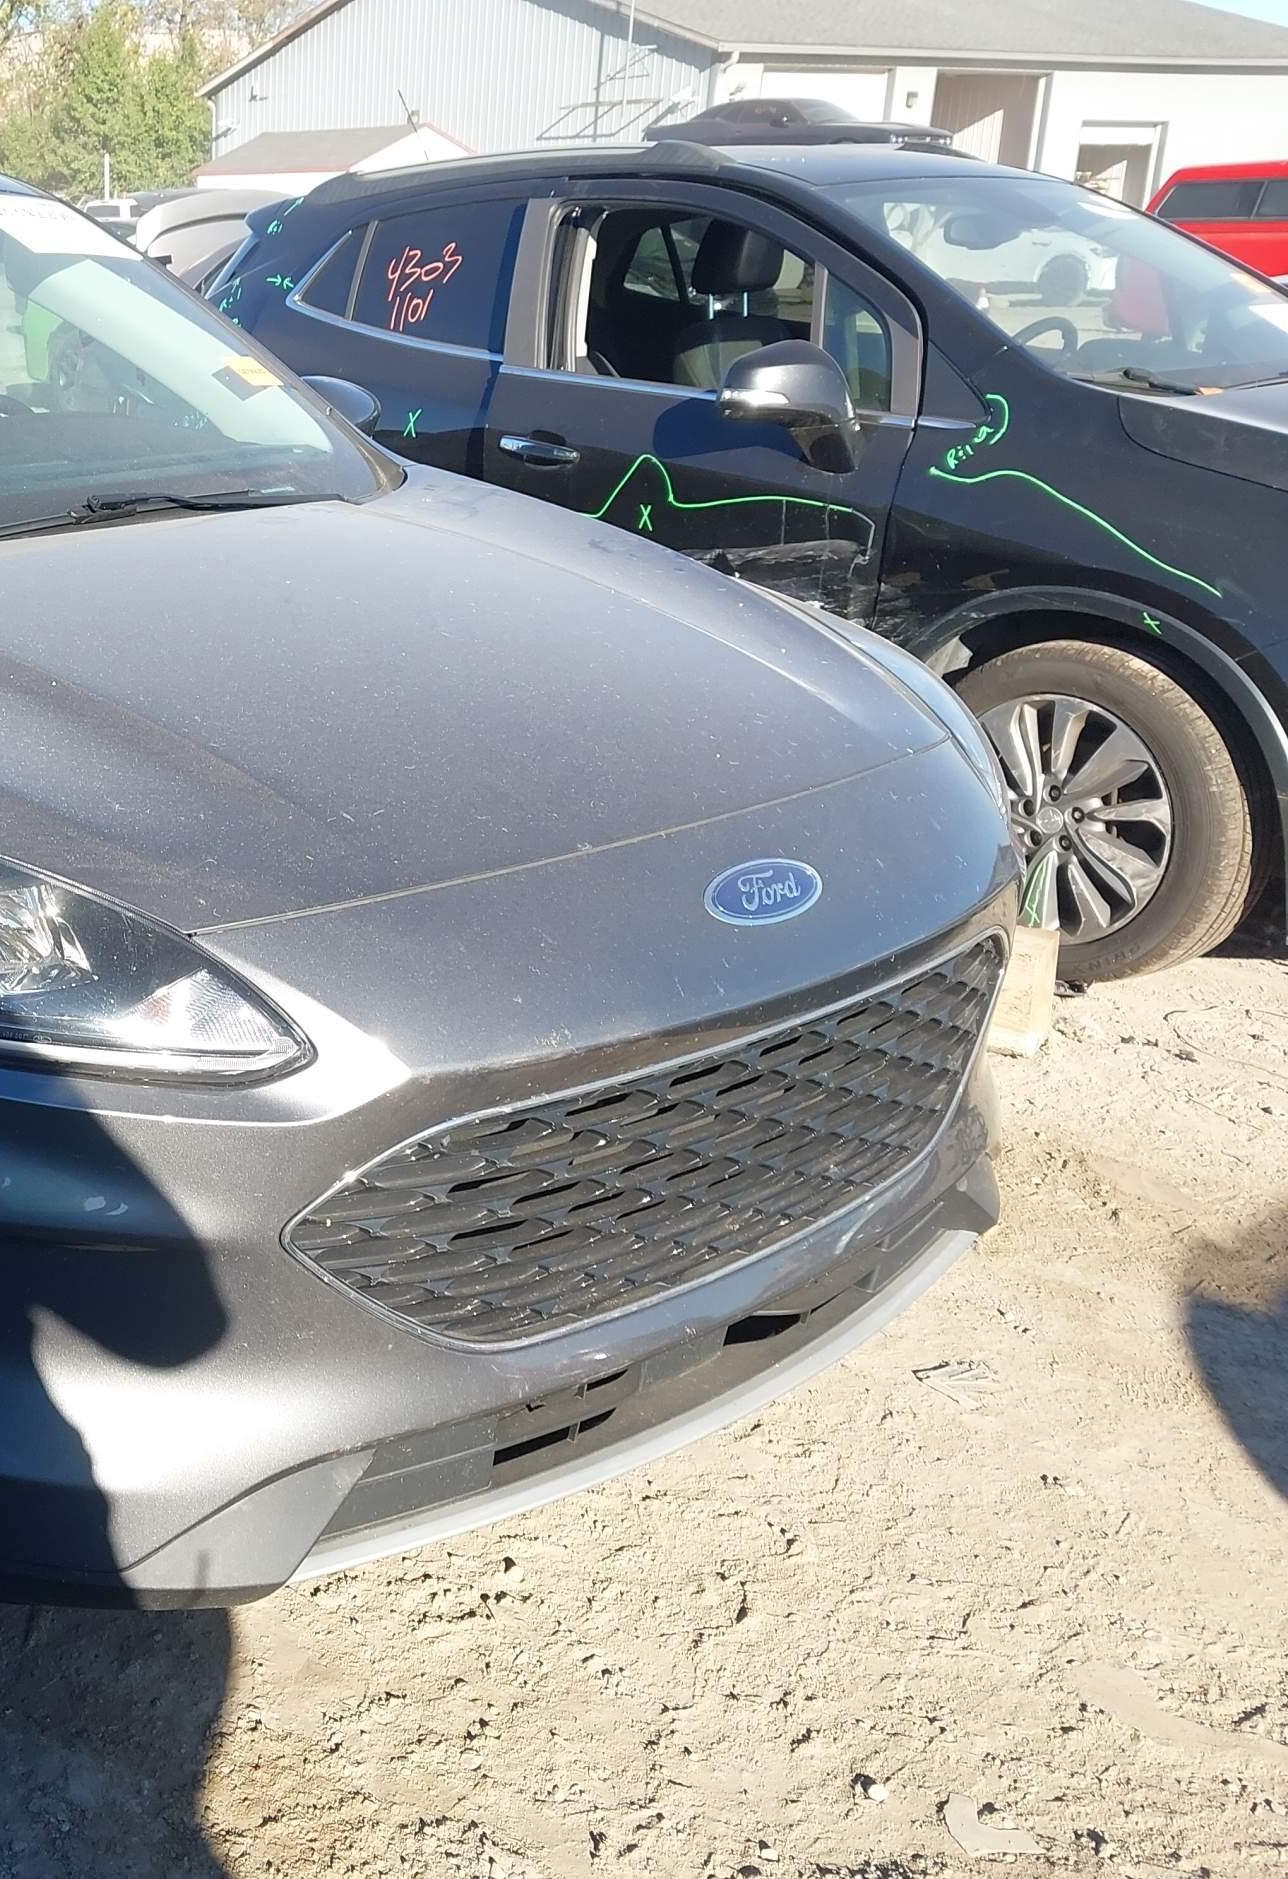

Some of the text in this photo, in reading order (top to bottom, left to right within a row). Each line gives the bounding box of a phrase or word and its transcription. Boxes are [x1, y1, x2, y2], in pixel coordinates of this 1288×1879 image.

[387, 241, 463, 302] 4303
[389, 288, 434, 332] 1101
[737, 869, 801, 912] Ford
